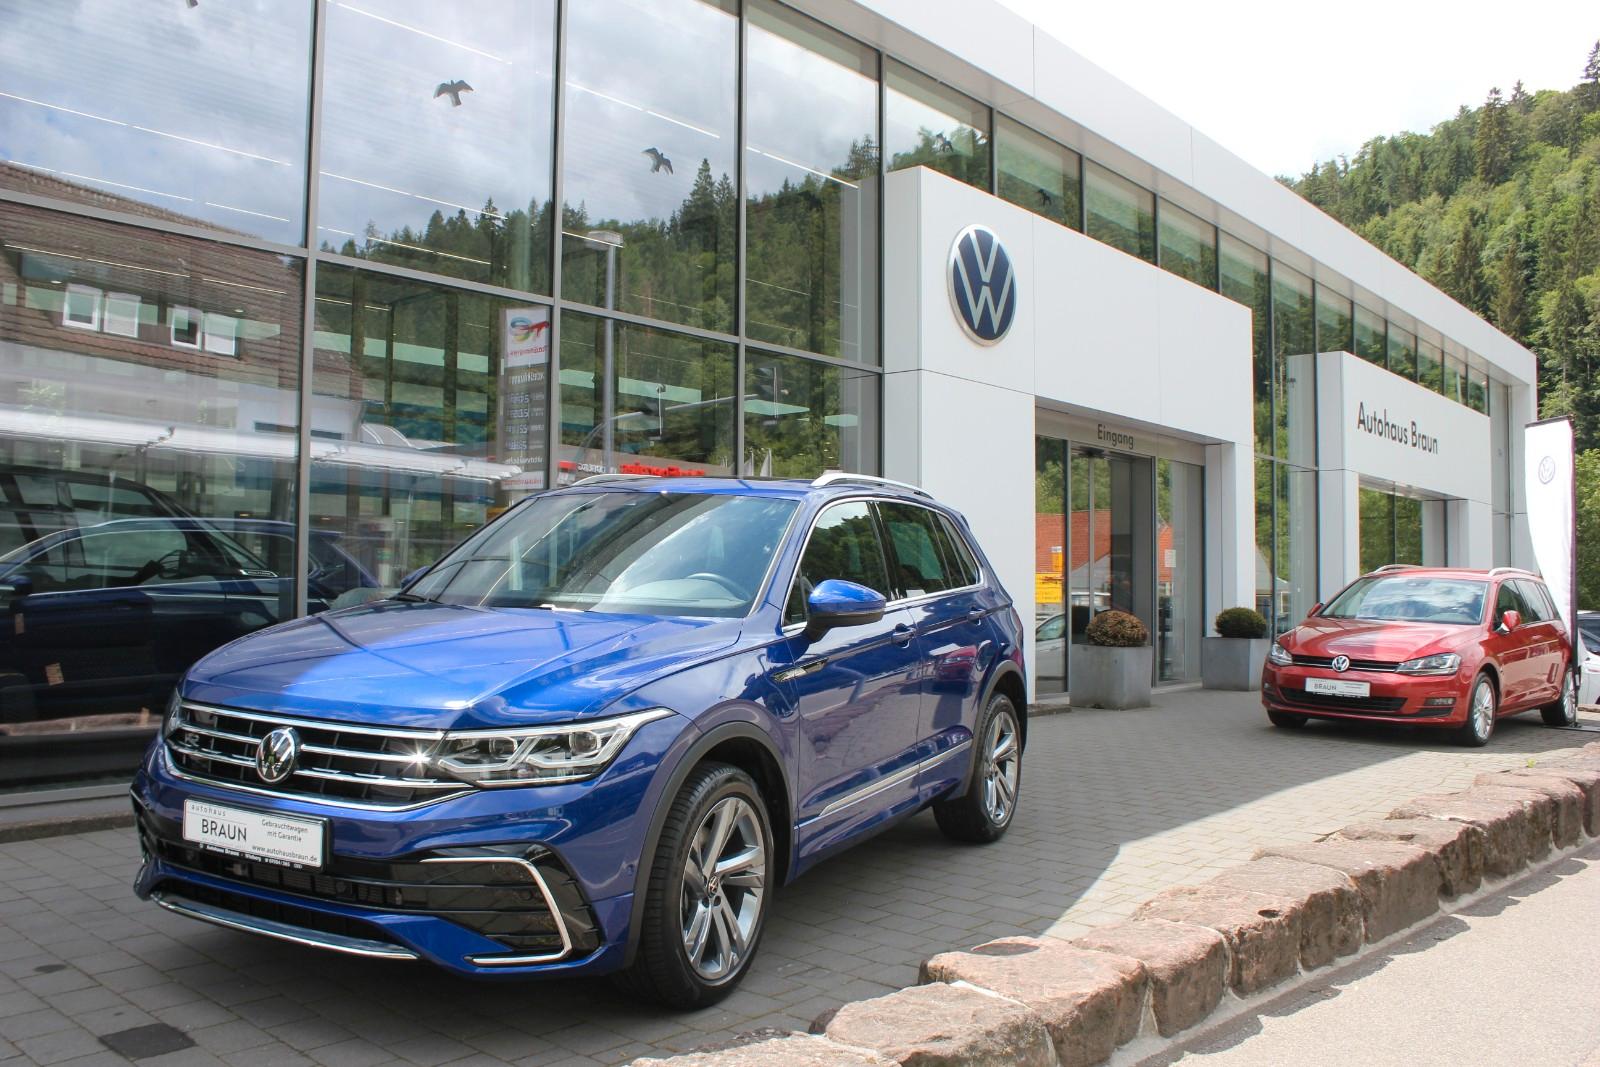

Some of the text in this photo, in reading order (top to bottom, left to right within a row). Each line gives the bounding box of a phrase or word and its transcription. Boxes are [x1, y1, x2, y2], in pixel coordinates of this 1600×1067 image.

[948, 225, 1016, 344] VW
[1097, 423, 1134, 450] Eingang
[1357, 401, 1438, 455] Autohaus Braun
[191, 804, 227, 817] autohaus
[201, 818, 247, 842] BRAUN
[261, 819, 309, 834] Gebrauchtwagen
[278, 832, 302, 842] Garantie
[252, 844, 318, 863] www.autohausbraun.de
